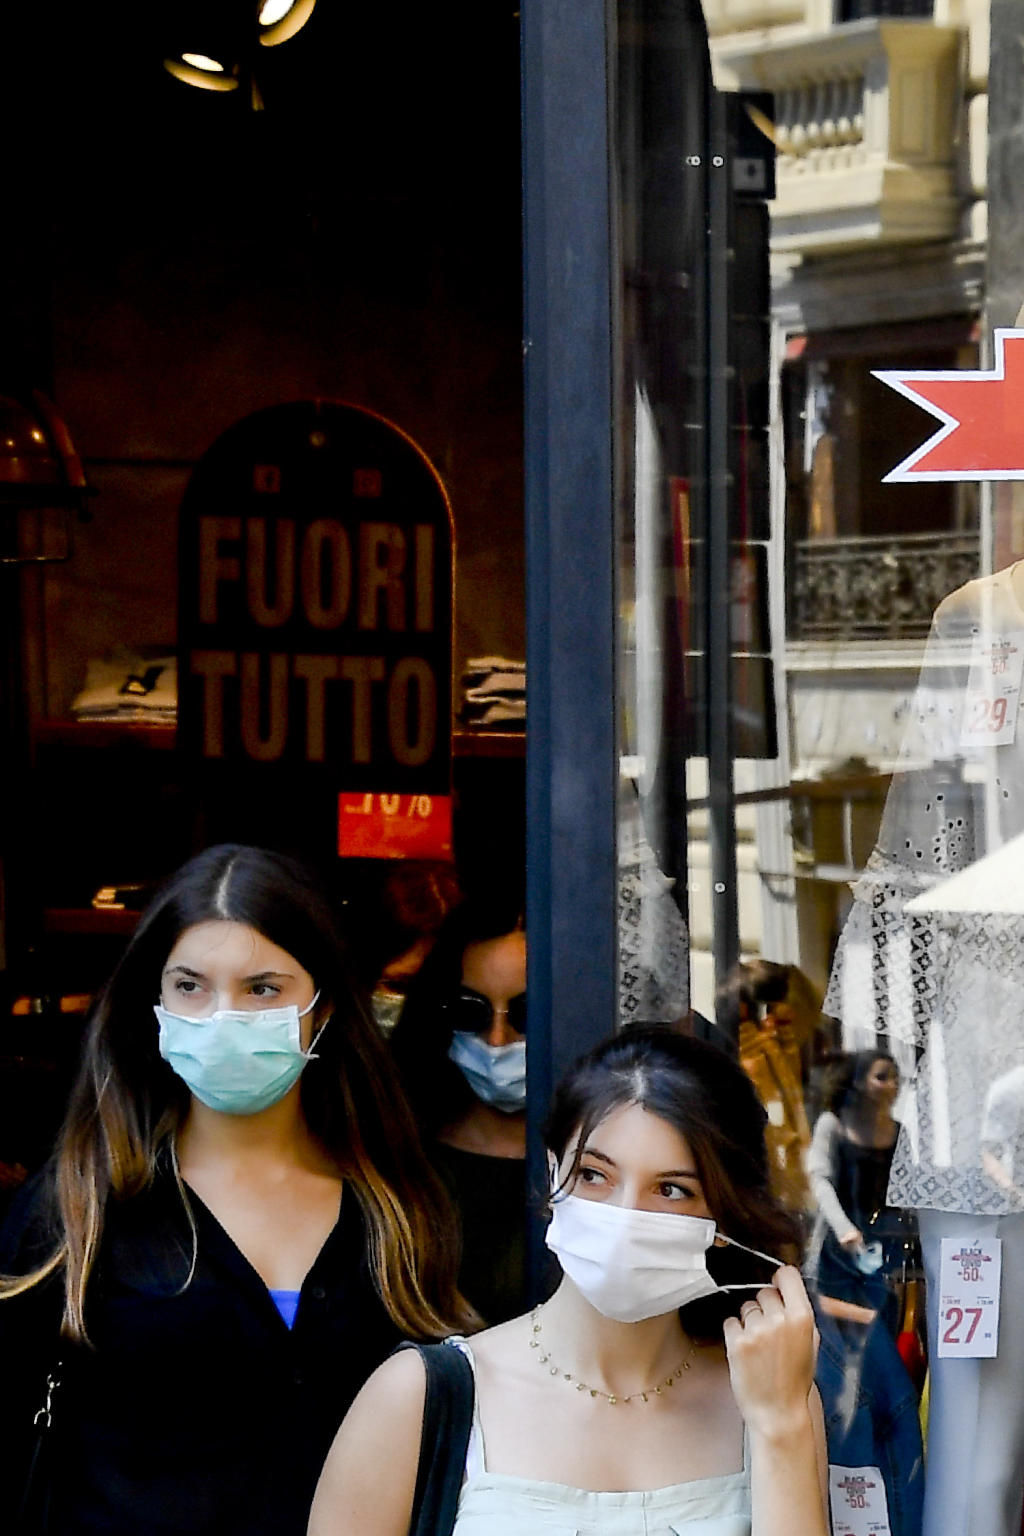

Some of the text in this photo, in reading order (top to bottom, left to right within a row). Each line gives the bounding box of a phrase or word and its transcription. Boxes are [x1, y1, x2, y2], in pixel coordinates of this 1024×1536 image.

[199, 516, 435, 632] FUORI
[191, 648, 437, 767] TUTTO
[943, 1307, 983, 1344] 27
